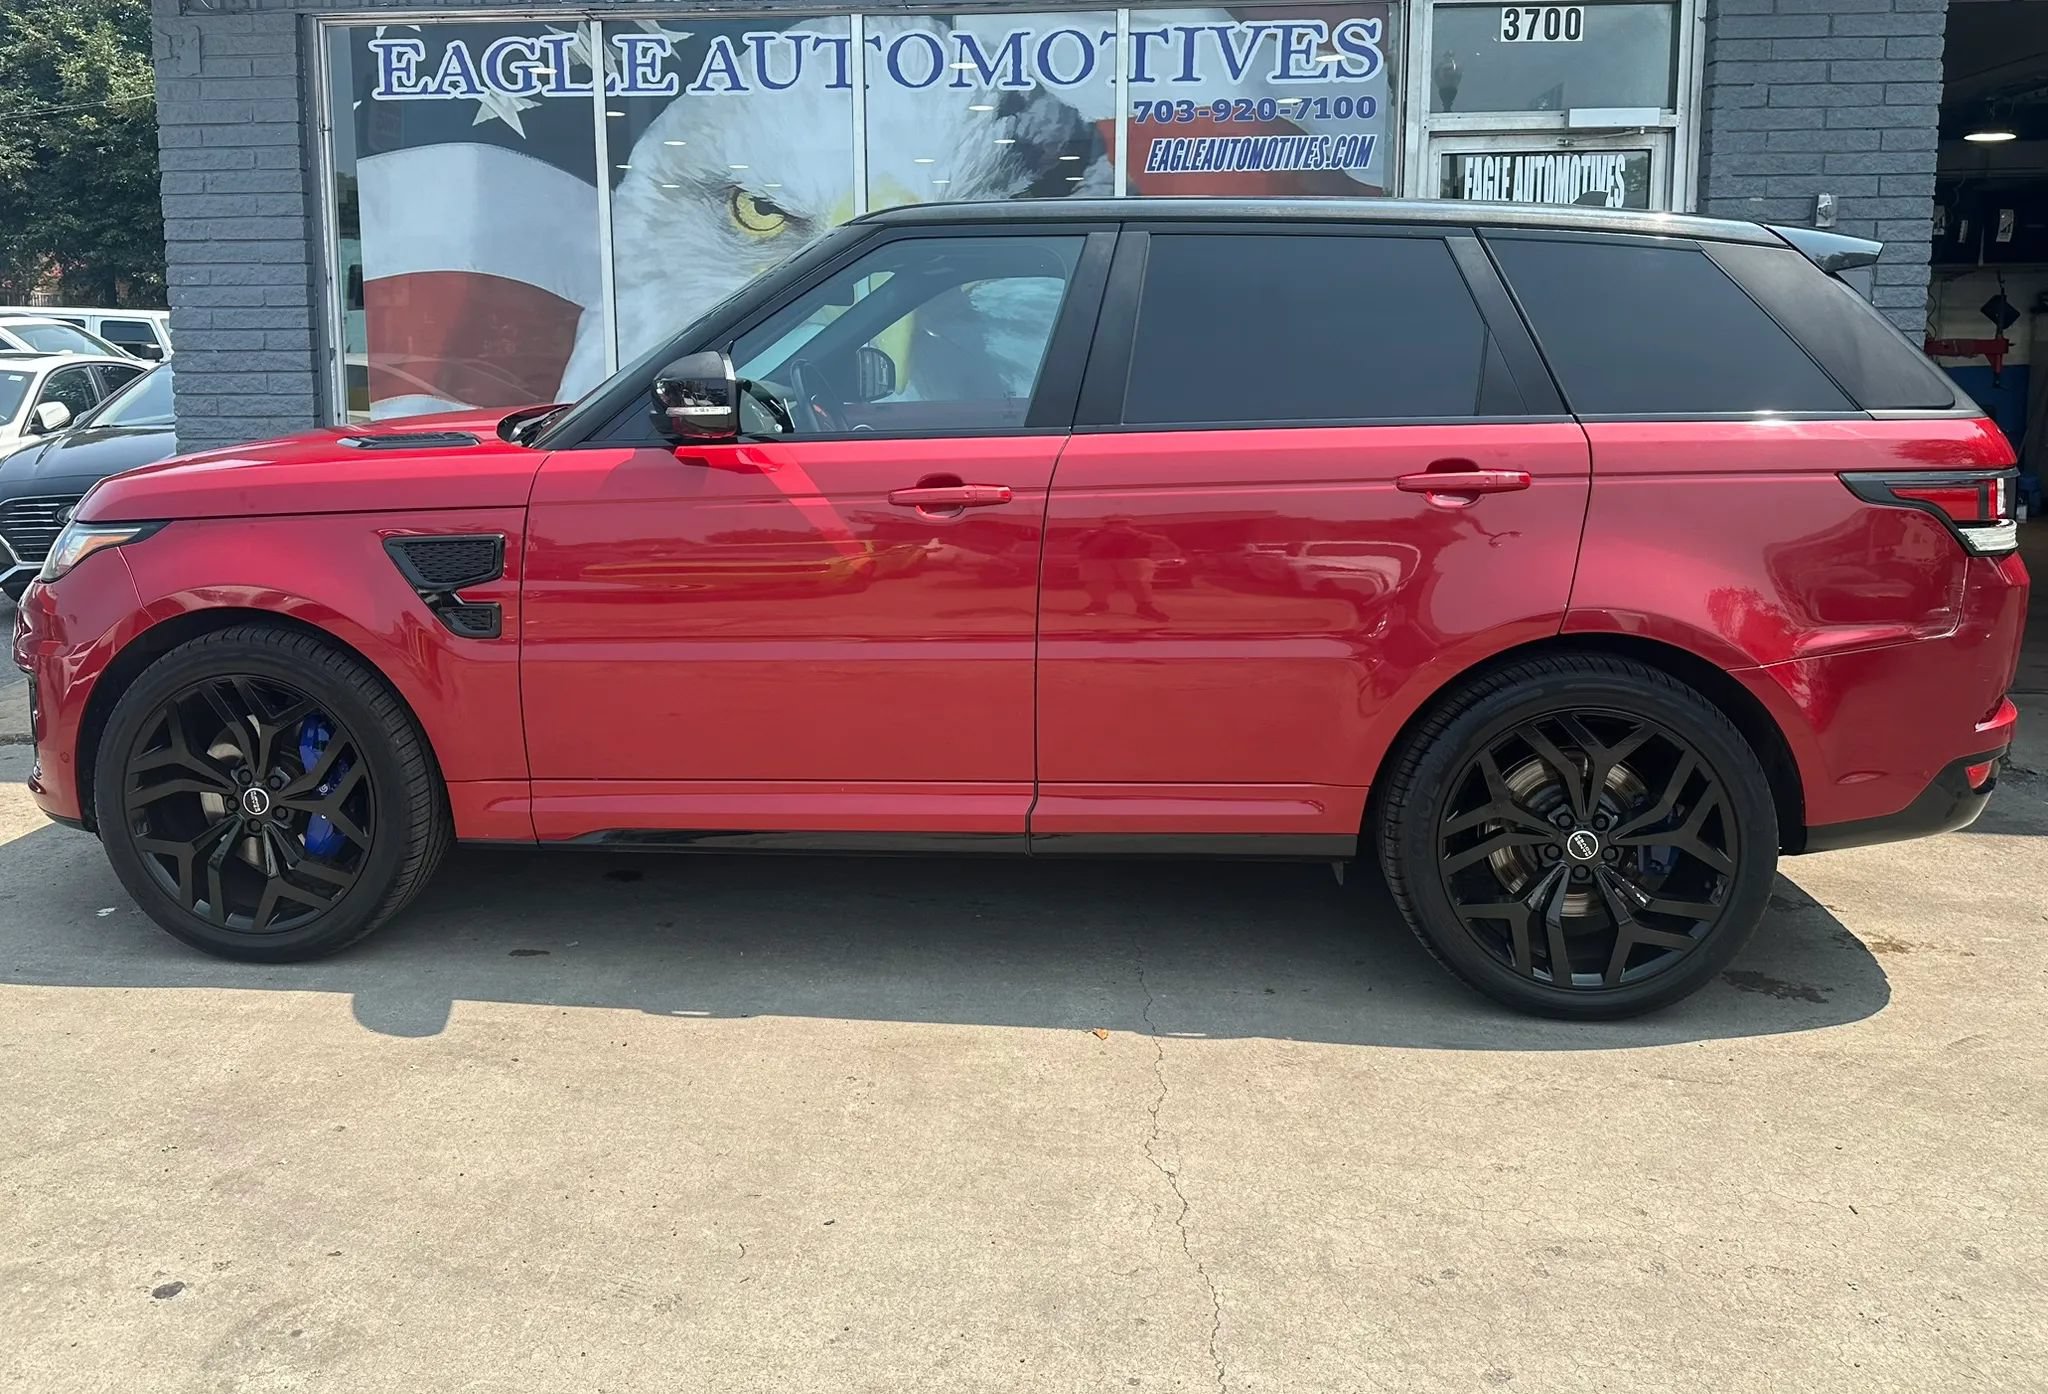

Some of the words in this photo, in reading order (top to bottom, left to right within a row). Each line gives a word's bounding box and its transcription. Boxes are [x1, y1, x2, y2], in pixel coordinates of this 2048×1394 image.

[1503, 8, 1581, 41] 3700
[368, 32, 679, 99] EAGLE
[685, 18, 1382, 95] AUTOMOTIVES
[1134, 97, 1377, 123] 703-920-7100
[1145, 134, 1377, 173] EAGLEAUTOMOTIVES.COM
